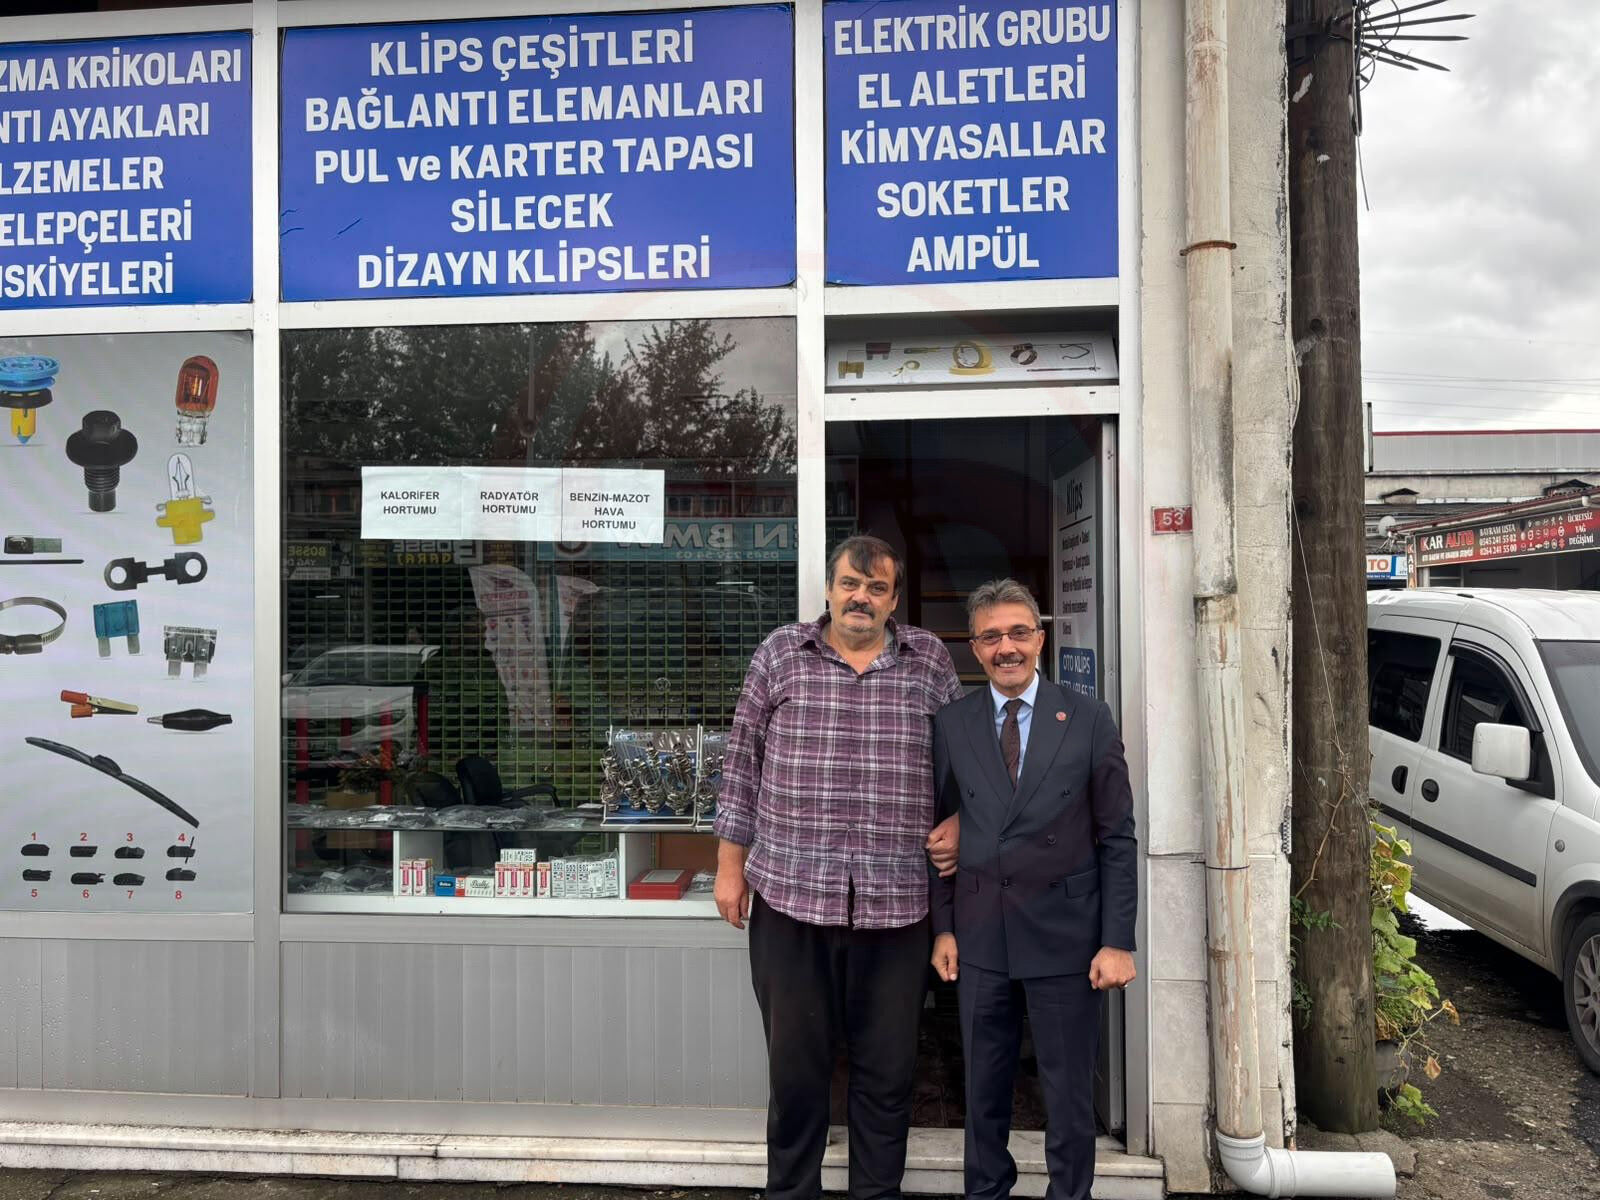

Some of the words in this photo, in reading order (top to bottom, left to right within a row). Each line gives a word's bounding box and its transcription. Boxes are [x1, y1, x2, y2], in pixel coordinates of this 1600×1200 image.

[834, 5, 990, 55] ELEKTRİK
[997, 5, 1110, 47] GRUBU
[370, 32, 483, 76] KLİPS
[492, 20, 693, 80] ÇEŞİTLERİ
[67, 47, 241, 89] KRİKOLARI
[858, 73, 902, 109] EL
[909, 54, 1086, 107] ALETLERİ
[305, 88, 497, 132] BAĞLANTI
[508, 79, 764, 125] ELEMANLARI
[48, 102, 209, 142] AYAKLARI
[841, 118, 1107, 165] KİMYASALLAR
[315, 148, 389, 184] PUL
[397, 154, 440, 181] ve
[450, 139, 604, 180] KARTER
[613, 133, 754, 173] TAPASI
[0, 156, 164, 195] LZEMELER
[876, 175, 1070, 218] SOKETLER
[450, 189, 613, 233] SİLECEK
[0, 199, 192, 254] ELEPÇELERİ
[907, 225, 1040, 272] AMPÜL
[358, 245, 496, 289] DİZAYN
[507, 235, 711, 285] KLİPSLERİ
[0, 252, 173, 298] SKİYELERİ
[380, 490, 440, 501] KALORİFER
[480, 490, 539, 502] RADYATÖR
[570, 492, 650, 504] BENZİN-MAZOT
[383, 505, 437, 515] HORTUMU
[482, 504, 536, 514] HORTUMU
[594, 507, 624, 516] HAVA
[582, 519, 636, 530] HORTUMU
[1162, 511, 1184, 526] 53
[1420, 534, 1443, 551] KAR
[1445, 530, 1475, 548] AUTO
[31, 832, 37, 841] 1
[80, 832, 87, 842] 2
[126, 832, 133, 842] 3
[178, 833, 186, 842] 4
[31, 889, 38, 898] 5
[83, 889, 89, 898] 6
[127, 890, 134, 899] 7
[175, 890, 182, 900] 8
